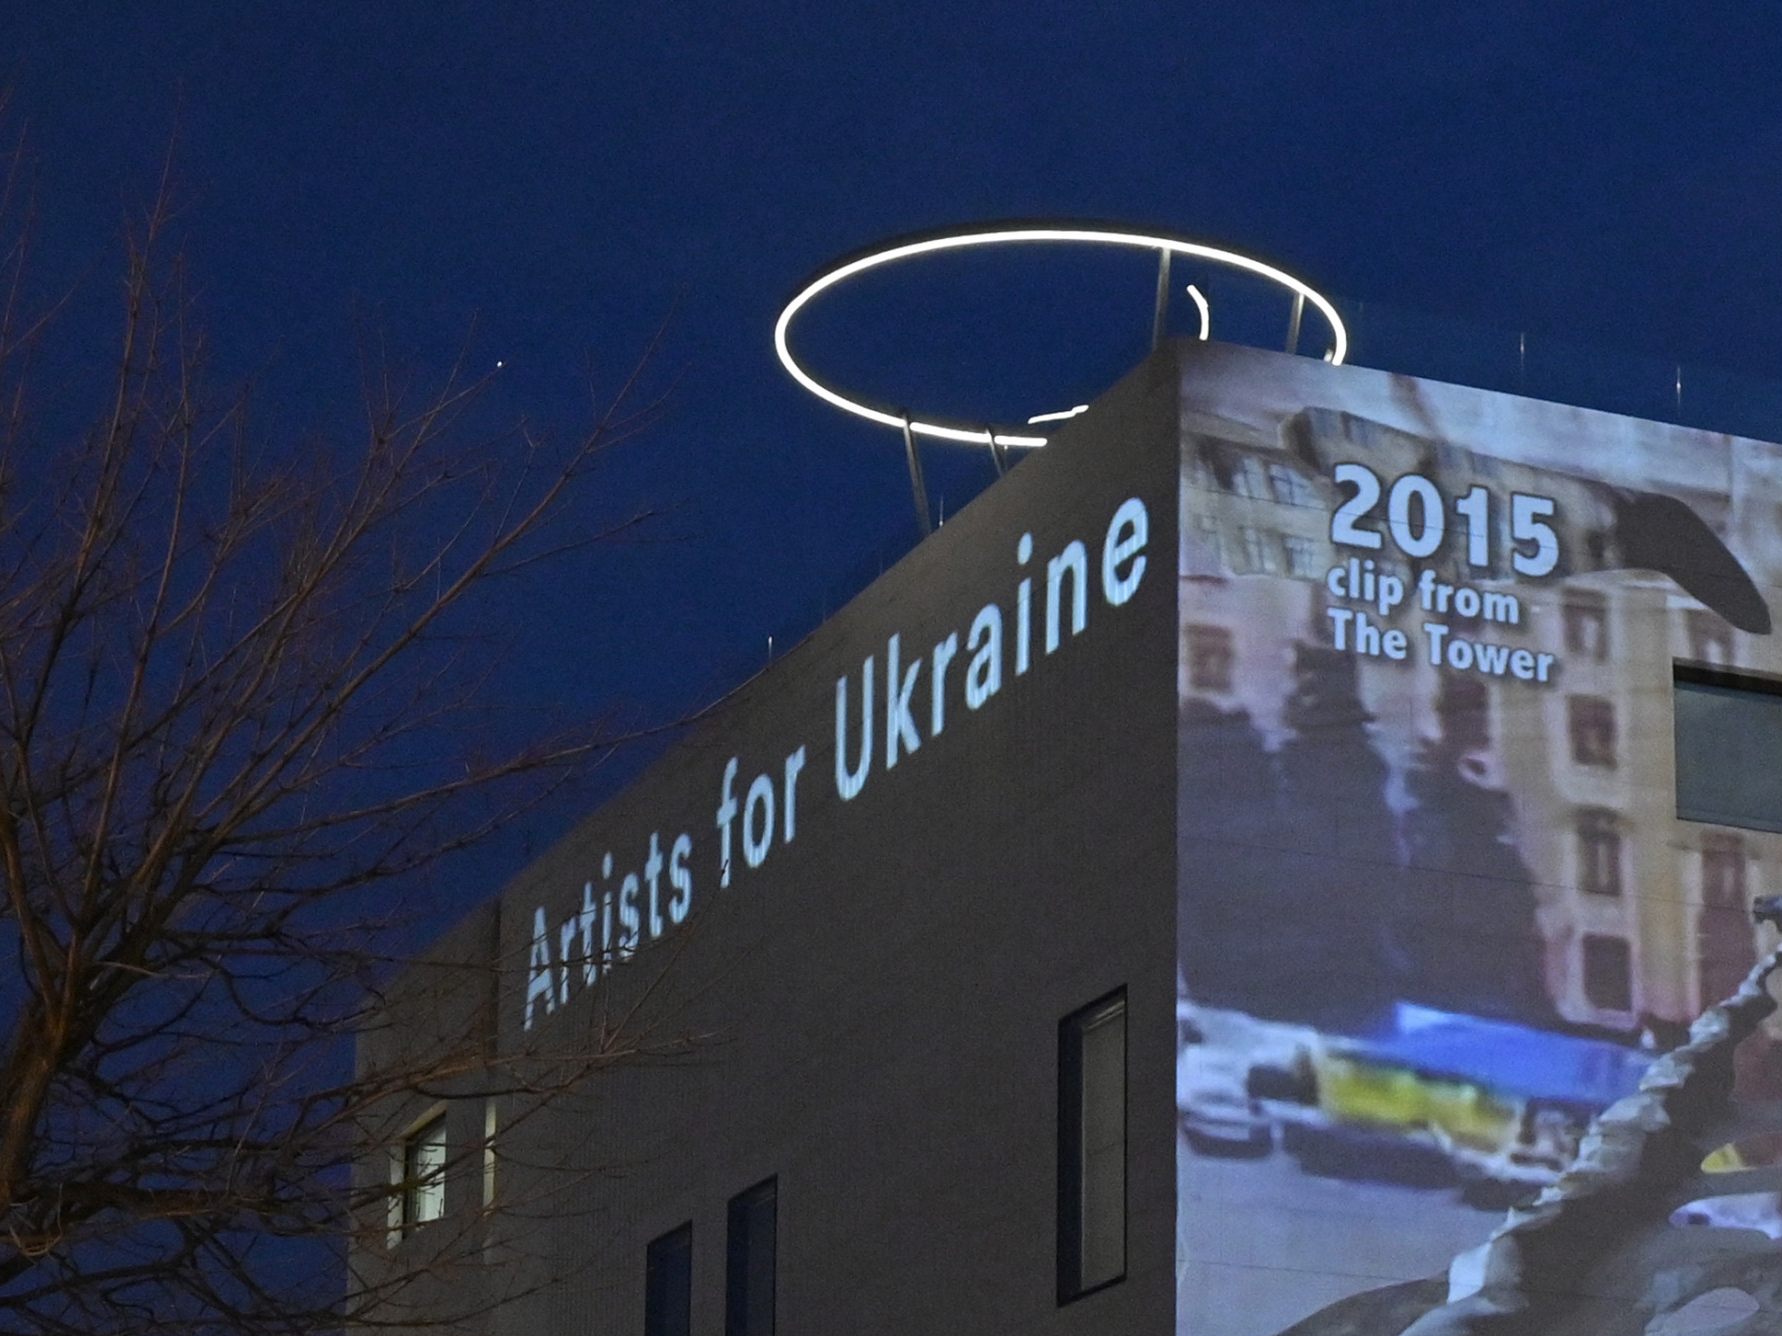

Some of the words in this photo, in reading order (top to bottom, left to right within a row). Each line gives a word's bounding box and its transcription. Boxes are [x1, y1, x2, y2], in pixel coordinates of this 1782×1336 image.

[1330, 463, 1559, 577] 2015
[1327, 557, 1403, 616] clip
[1418, 568, 1519, 624] from
[1327, 606, 1408, 660] The
[1424, 622, 1555, 682] Tower
[523, 830, 693, 1031] Artists
[716, 744, 806, 888] for
[834, 497, 1150, 801] Ukraine
